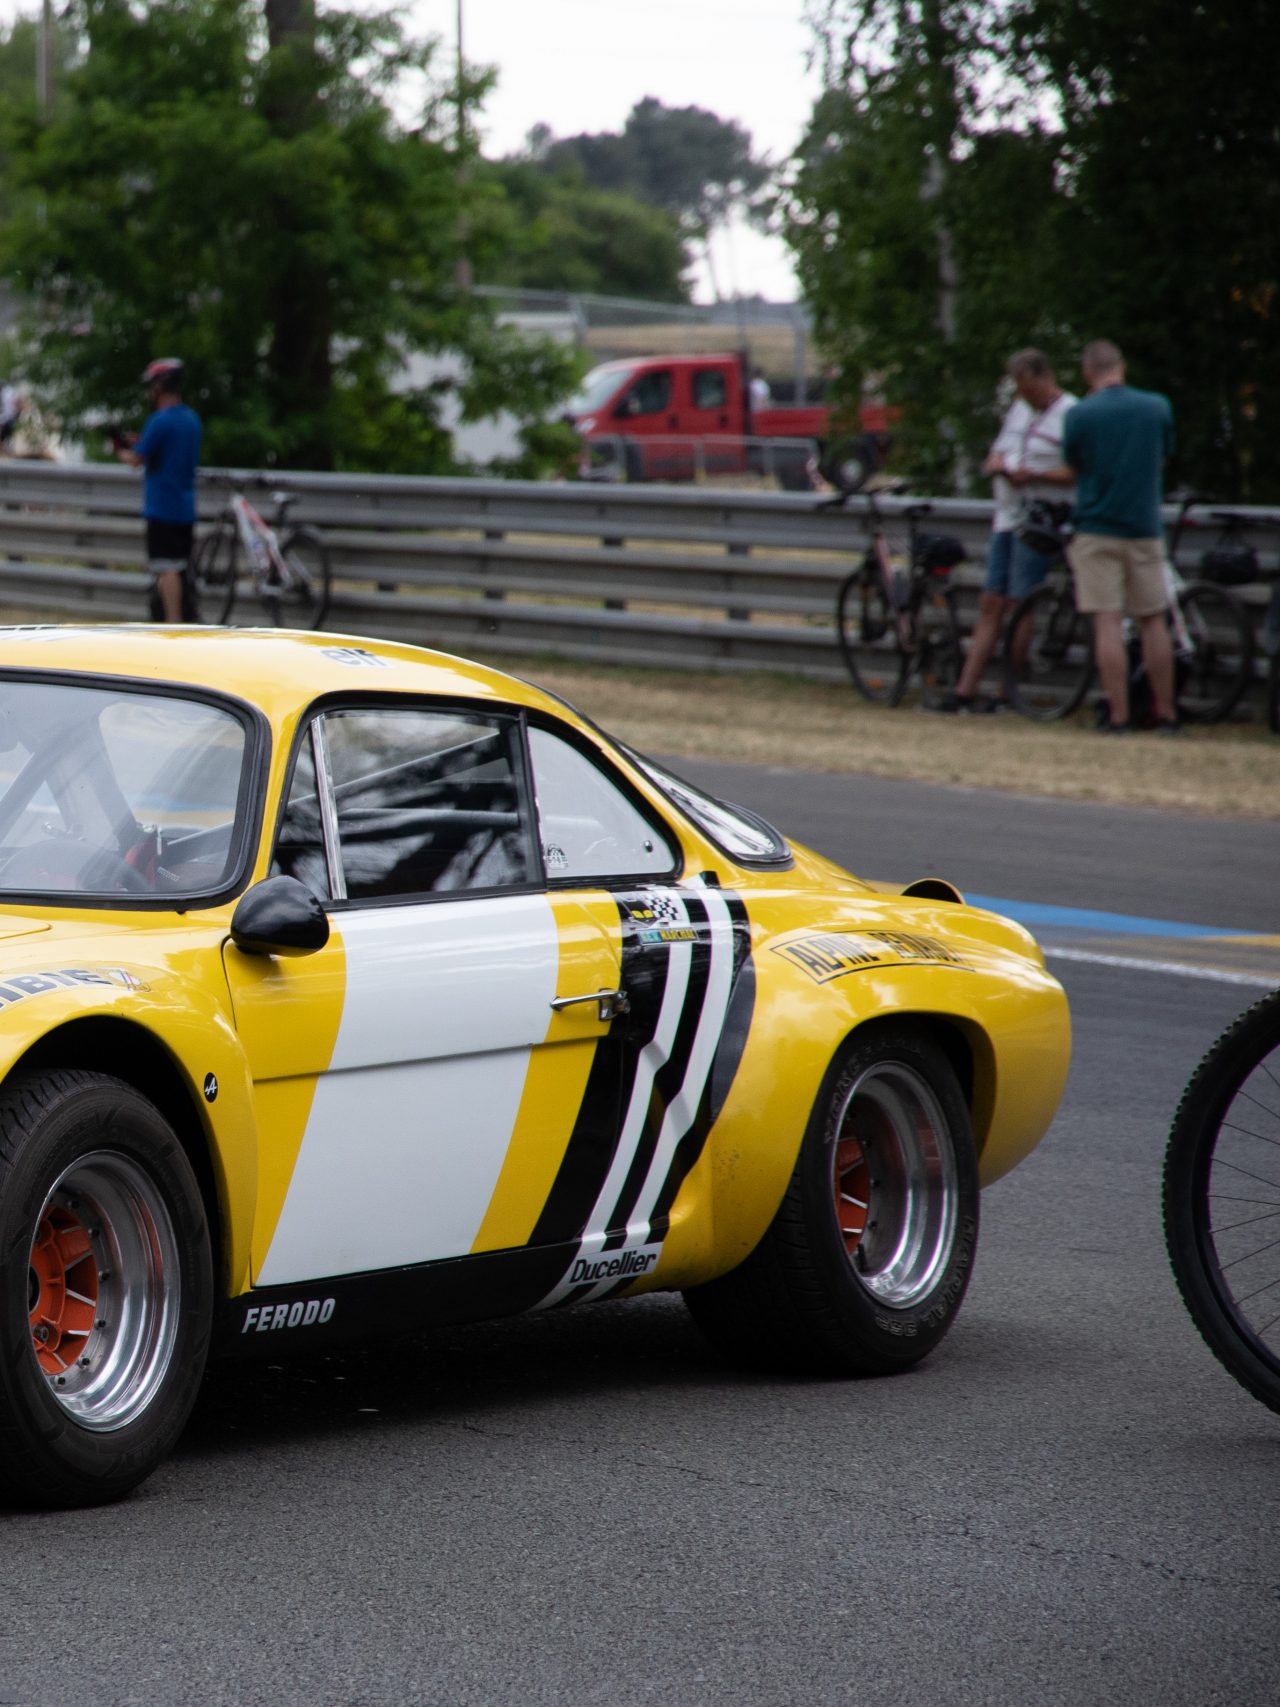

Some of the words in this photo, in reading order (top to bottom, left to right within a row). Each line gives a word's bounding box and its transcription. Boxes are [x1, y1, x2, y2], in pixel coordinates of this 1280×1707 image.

[786, 933, 880, 977] ALPINE
[569, 1250, 657, 1283] Ducellier
[241, 1298, 336, 1334] FERODO
